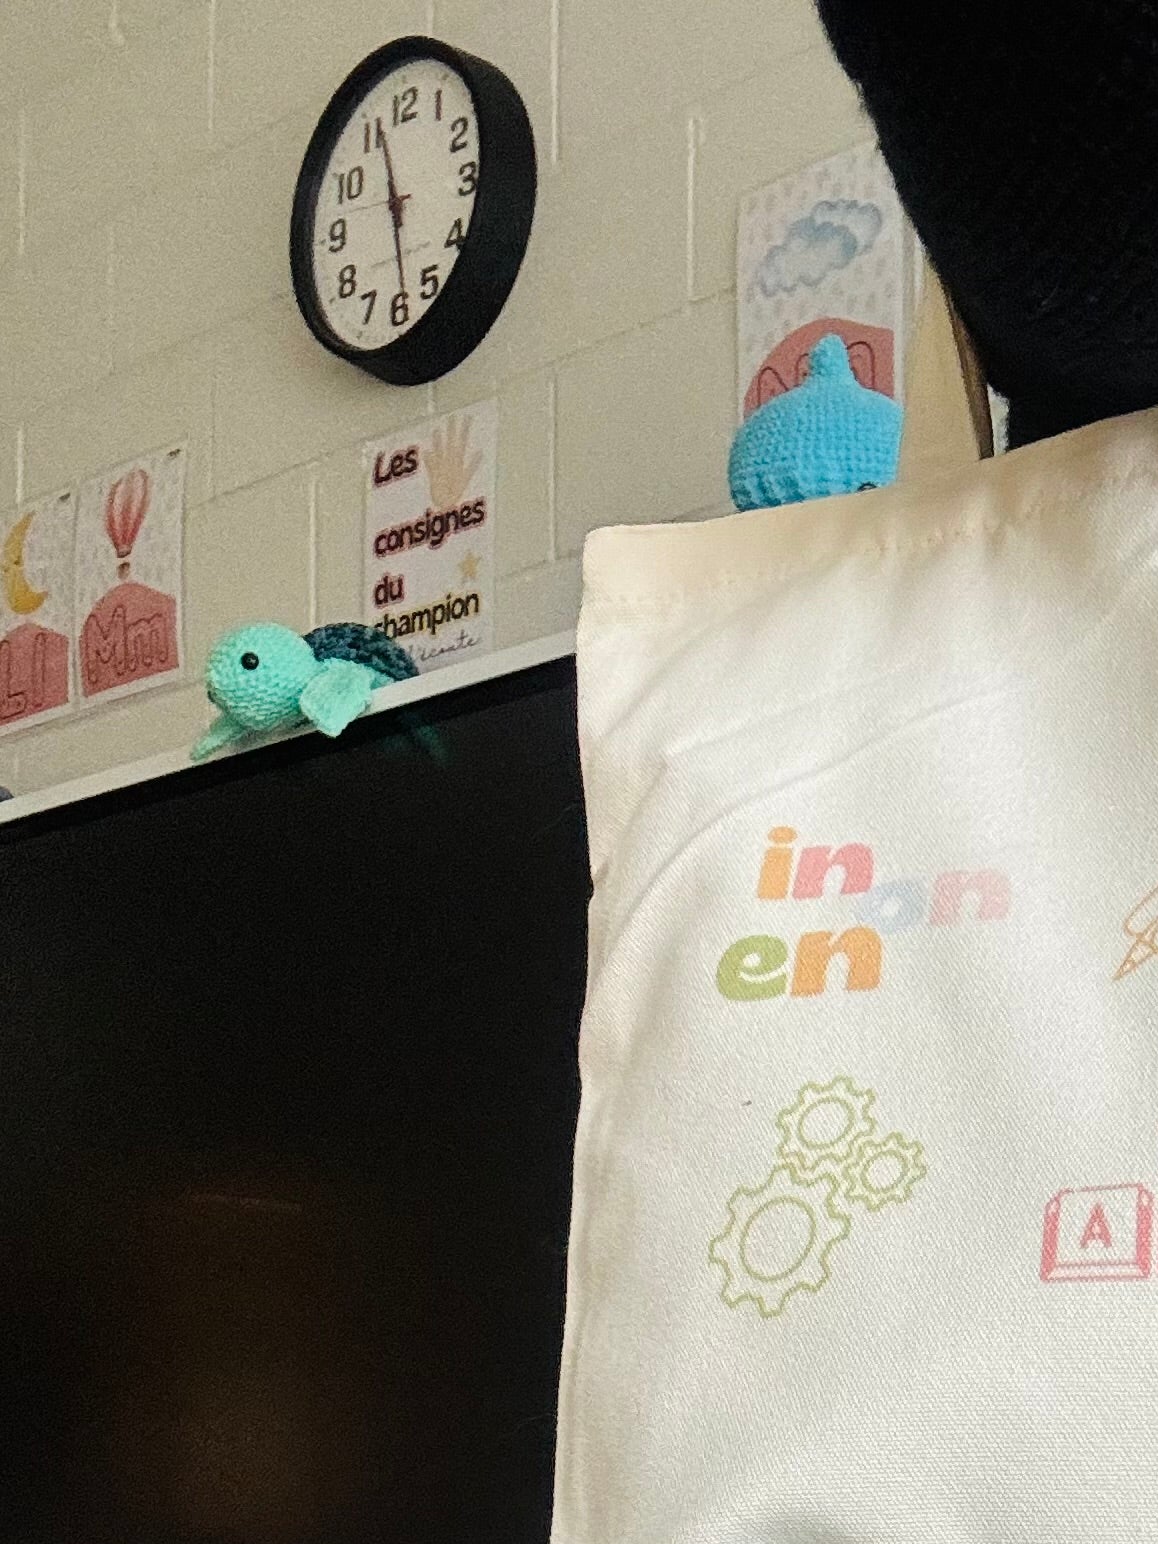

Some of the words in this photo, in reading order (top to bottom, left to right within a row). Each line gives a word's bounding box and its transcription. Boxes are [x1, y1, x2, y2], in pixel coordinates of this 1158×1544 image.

[391, 86, 419, 127] 12
[434, 89, 443, 121] 1
[363, 116, 385, 153] 11
[449, 117, 469, 153] 2
[336, 165, 364, 204] 10
[457, 161, 477, 197] 3
[328, 218, 348, 253] 9
[443, 217, 466, 252] 4
[338, 264, 358, 299] 8
[419, 264, 441, 300] 5
[360, 289, 378, 325] 7
[389, 291, 410, 327] 6
[373, 447, 419, 485] Les
[373, 498, 487, 557] consignes
[373, 574, 404, 606] du
[84, 605, 169, 684] Mm
[756, 826, 875, 901] in
[854, 868, 1011, 935] on
[716, 925, 884, 1001] en
[1080, 1203, 1112, 1248] A
